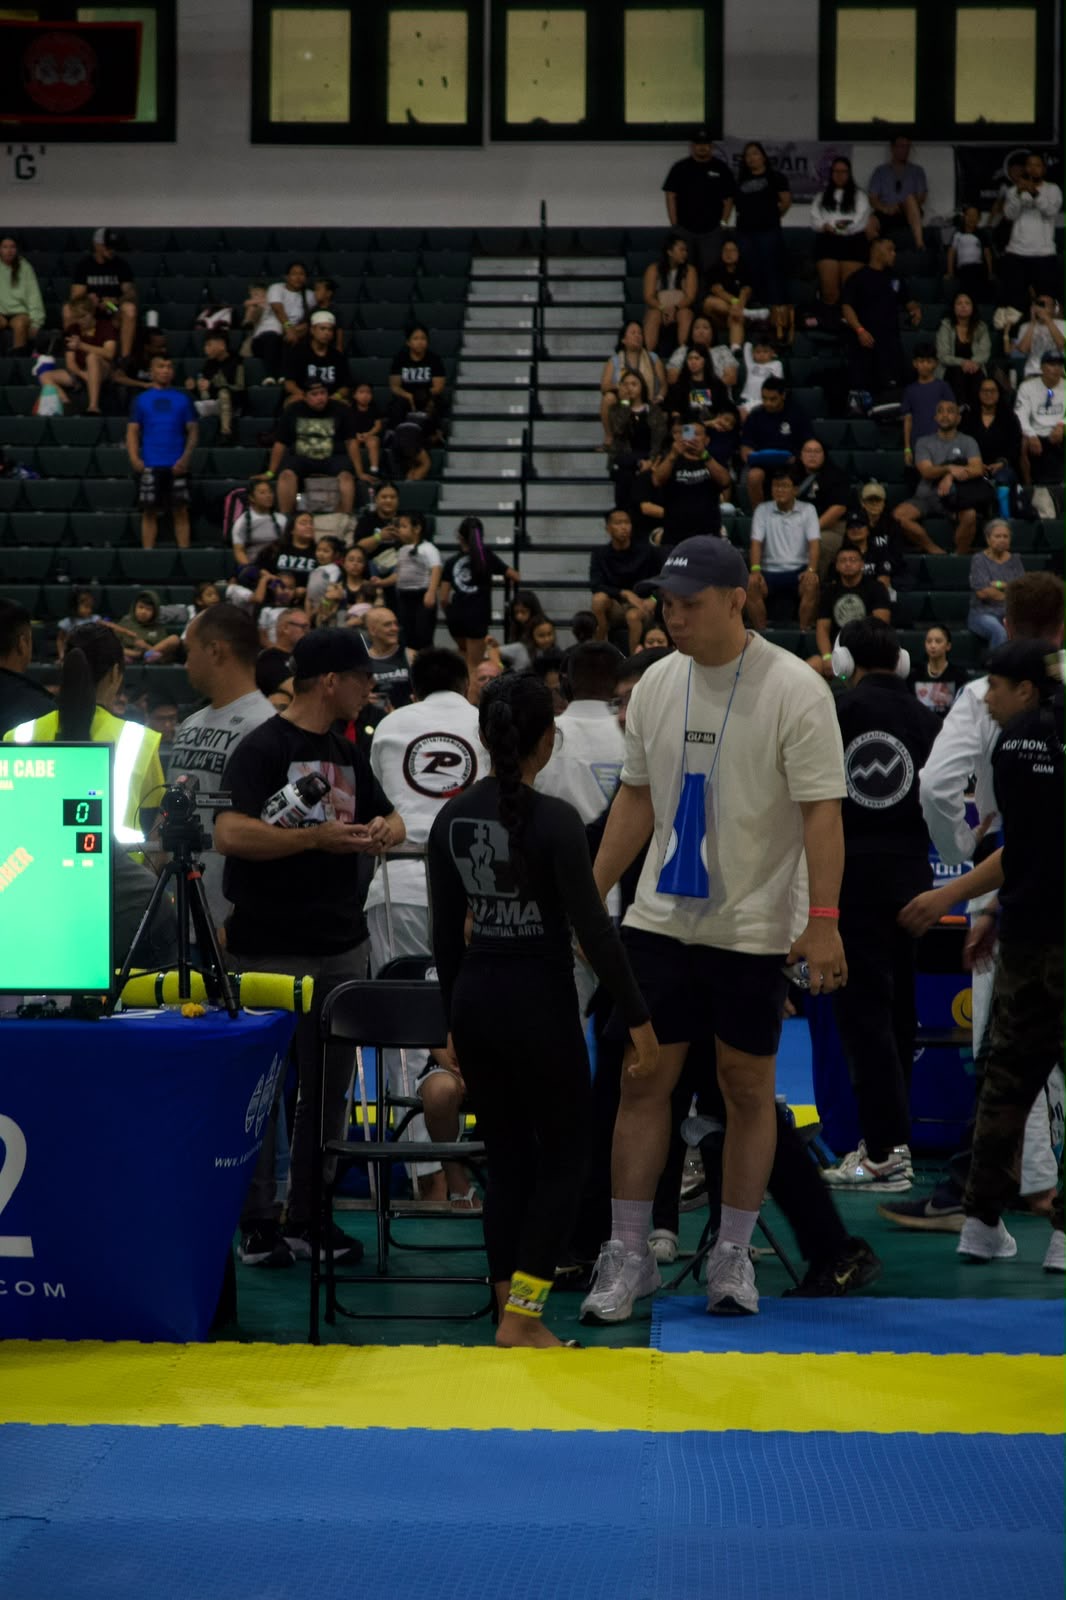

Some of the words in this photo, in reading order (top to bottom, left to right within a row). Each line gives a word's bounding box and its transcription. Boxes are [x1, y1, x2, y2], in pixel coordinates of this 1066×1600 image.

[16, 154, 36, 180] G
[277, 554, 317, 570] RYZE
[176, 727, 240, 750] ECURITY
[14, 760, 56, 778] CABE
[1032, 763, 1055, 775] GUAM
[75, 802, 90, 823] 0
[83, 833, 96, 851] 0
[518, 924, 545, 937] ARTS
